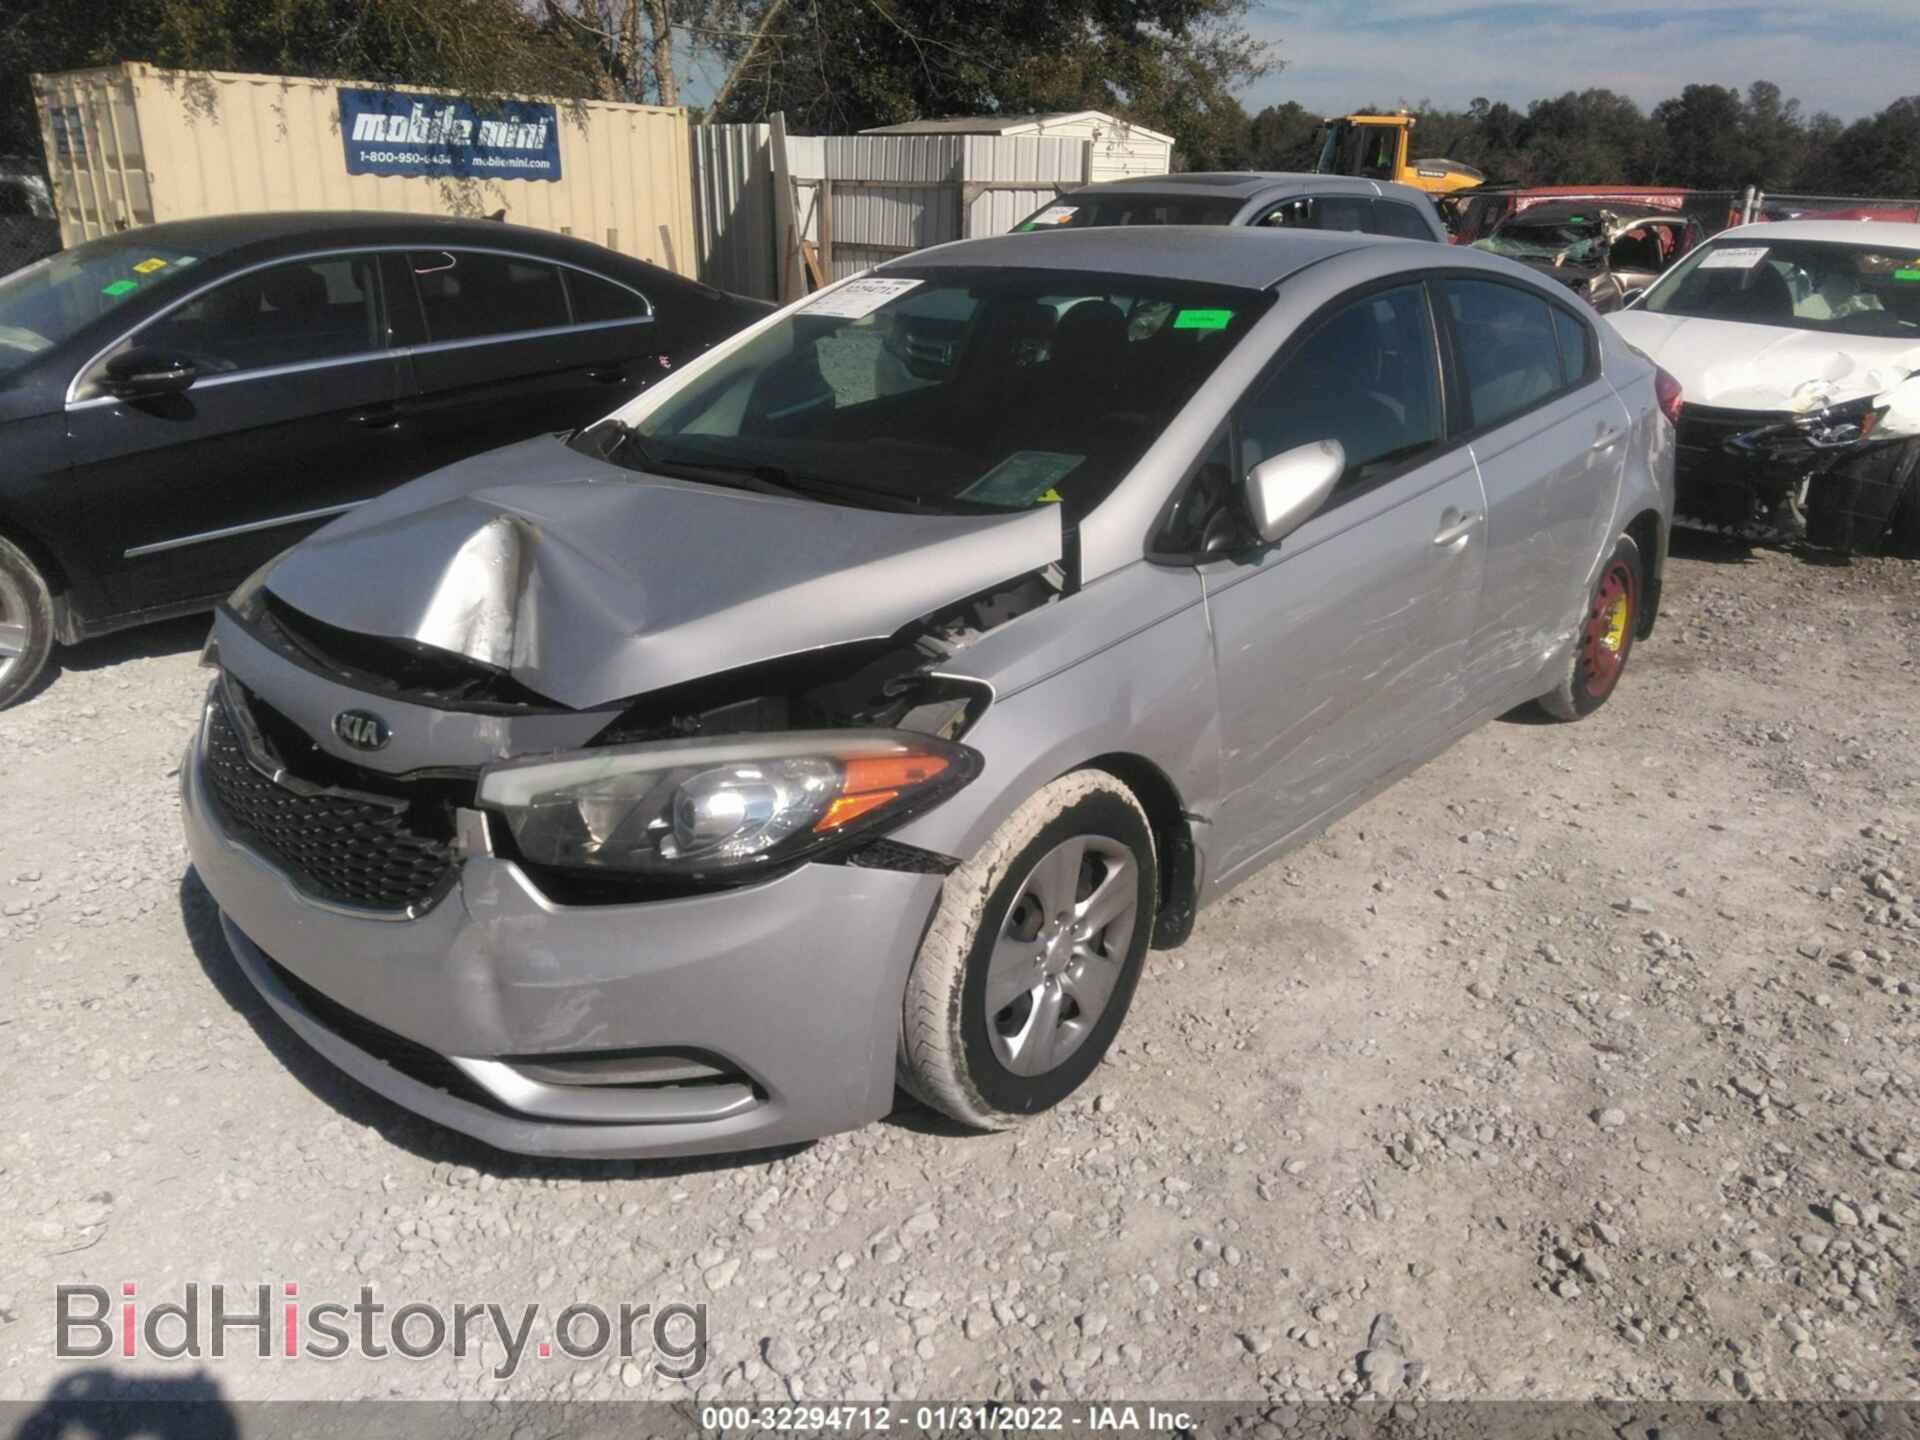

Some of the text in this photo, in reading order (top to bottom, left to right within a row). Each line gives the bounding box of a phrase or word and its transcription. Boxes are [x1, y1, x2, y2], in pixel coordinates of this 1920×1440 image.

[352, 101, 548, 150] mobile mini
[339, 713, 378, 746] KIA
